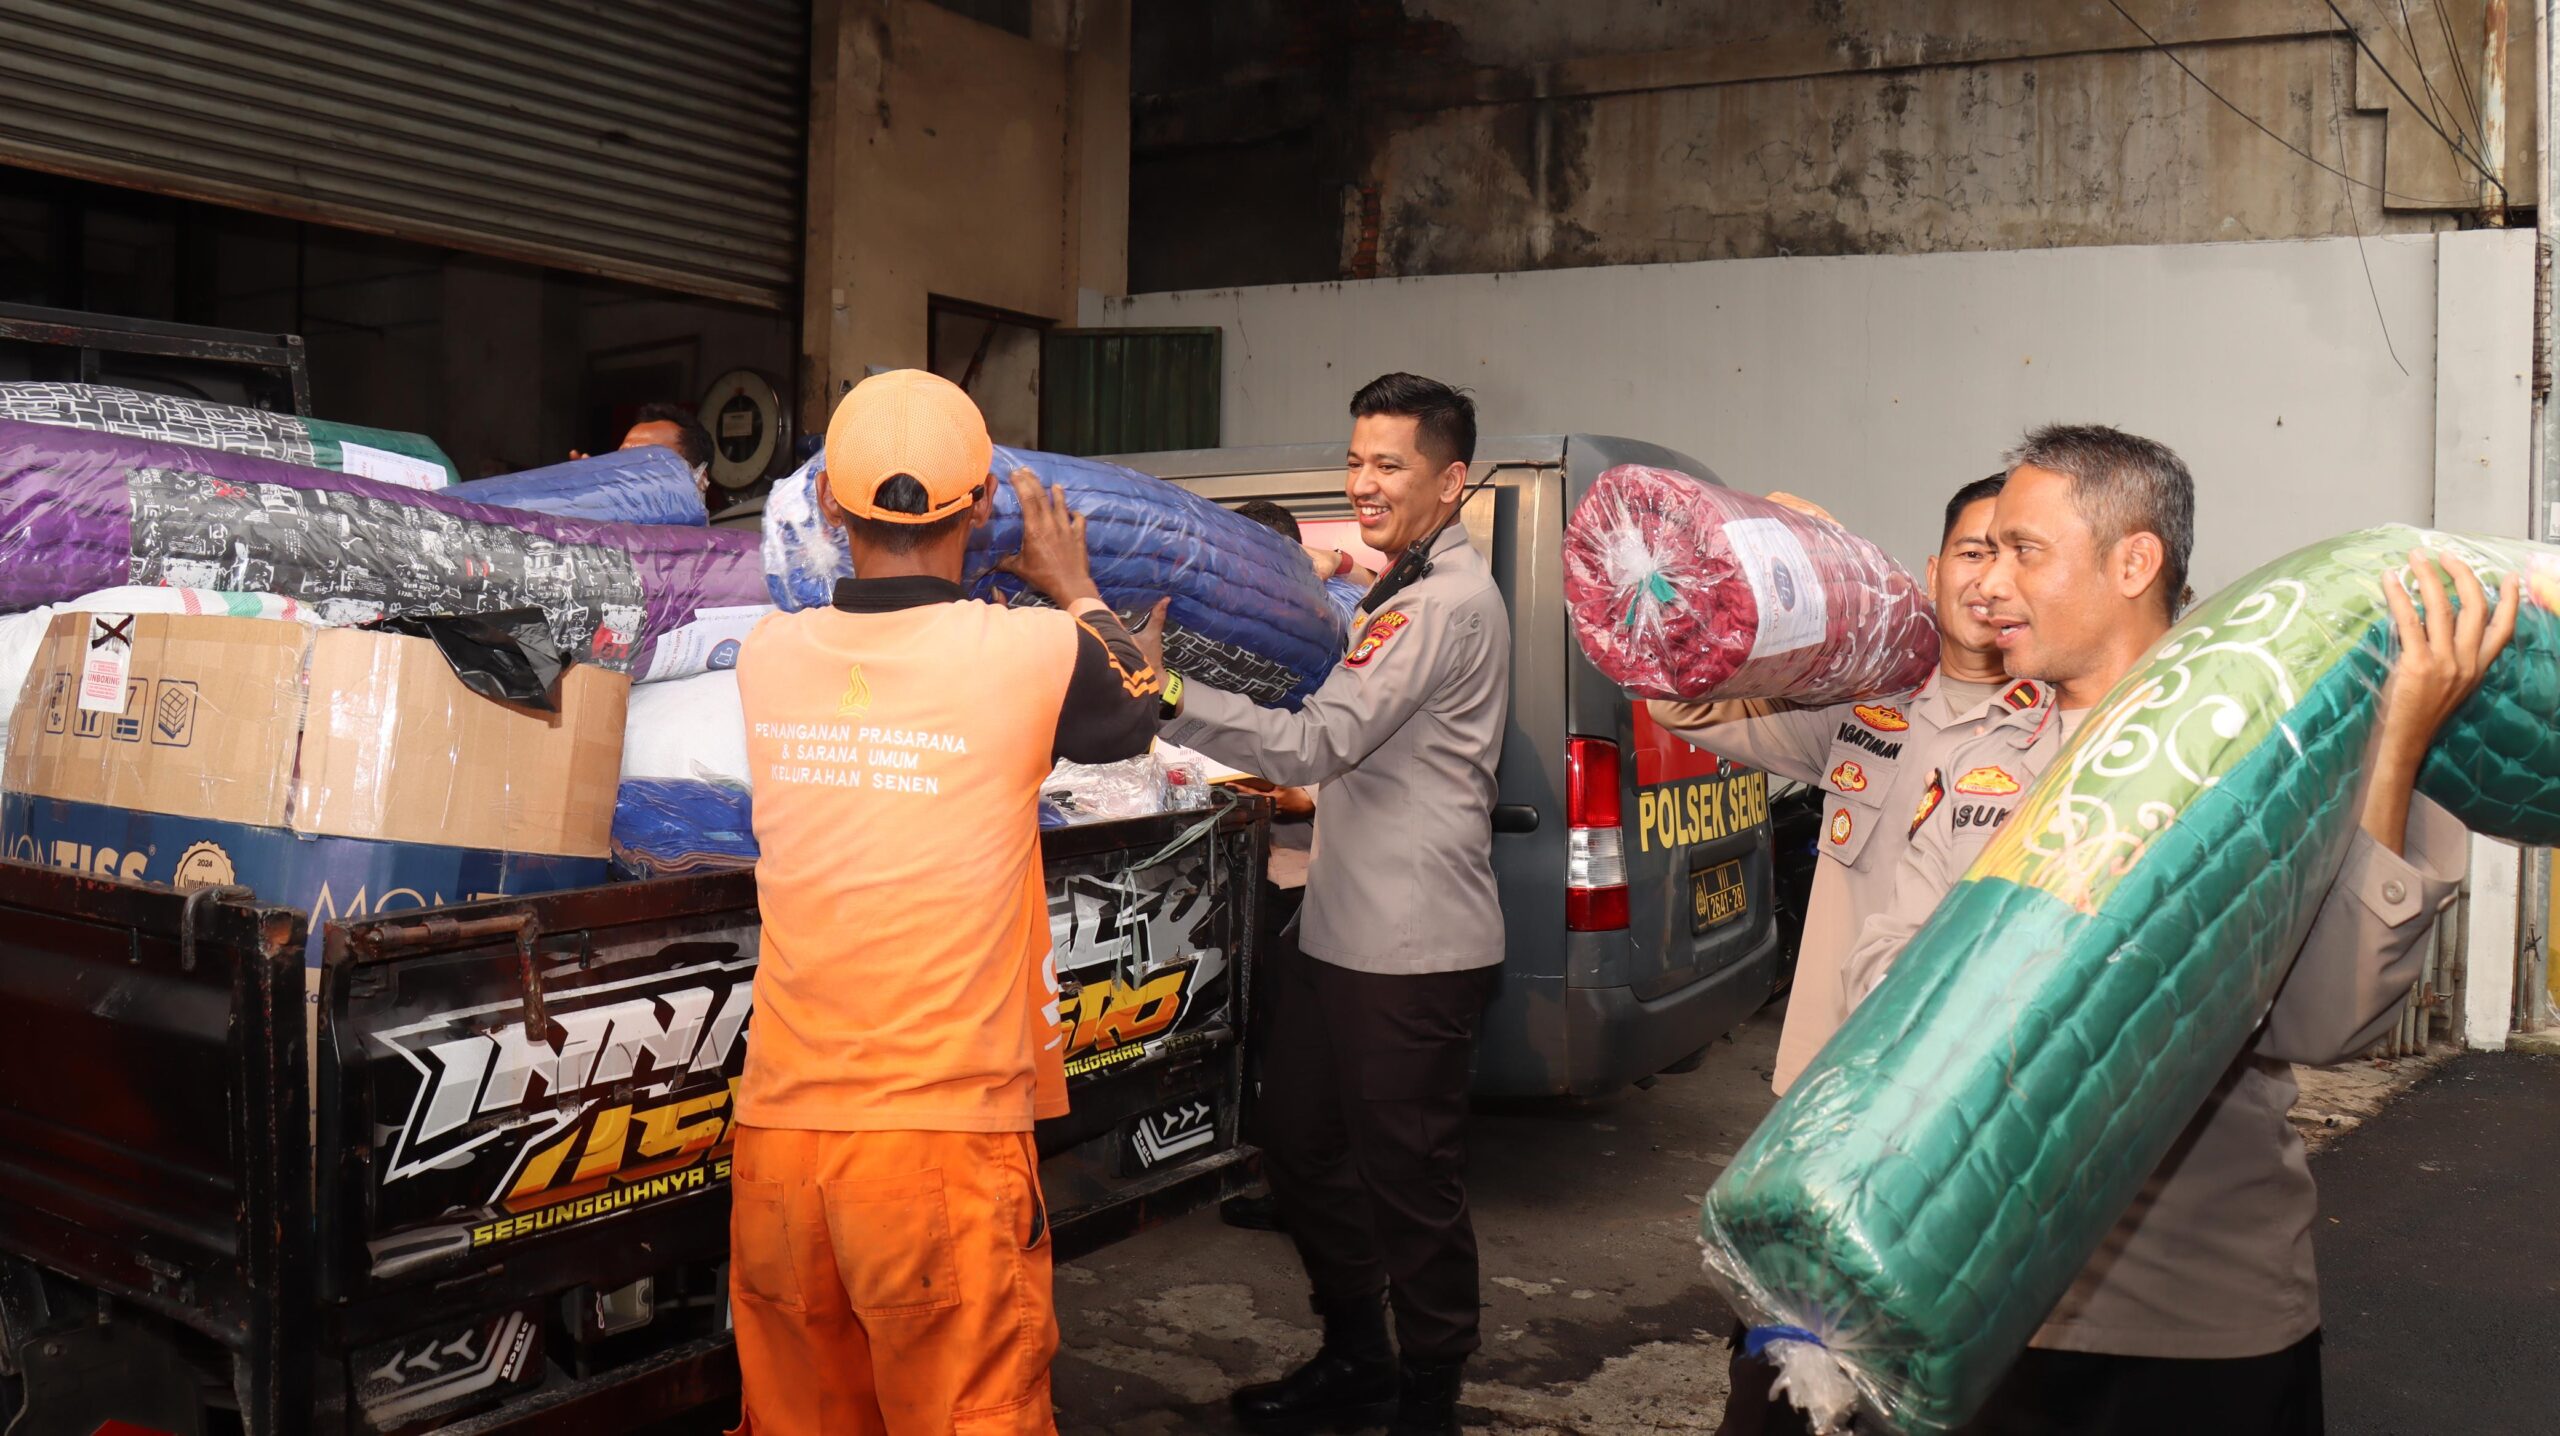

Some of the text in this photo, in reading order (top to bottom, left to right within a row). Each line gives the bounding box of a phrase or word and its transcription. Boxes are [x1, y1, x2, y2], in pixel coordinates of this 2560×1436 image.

[88, 673, 121, 687] UNBOXING
[755, 723, 967, 754] PENANGANAN PRASARANA
[782, 744, 919, 769] & SARANA UMUM
[771, 765, 939, 794] KELURAHAN SENEN
[1639, 770, 1768, 852] POLSEK SENEN
[197, 859, 213, 868] 2024
[1711, 886, 1743, 918] 2641-28
[473, 1166, 705, 1248] SESUNGGUHNYA
[501, 1321, 529, 1379] Bogie
